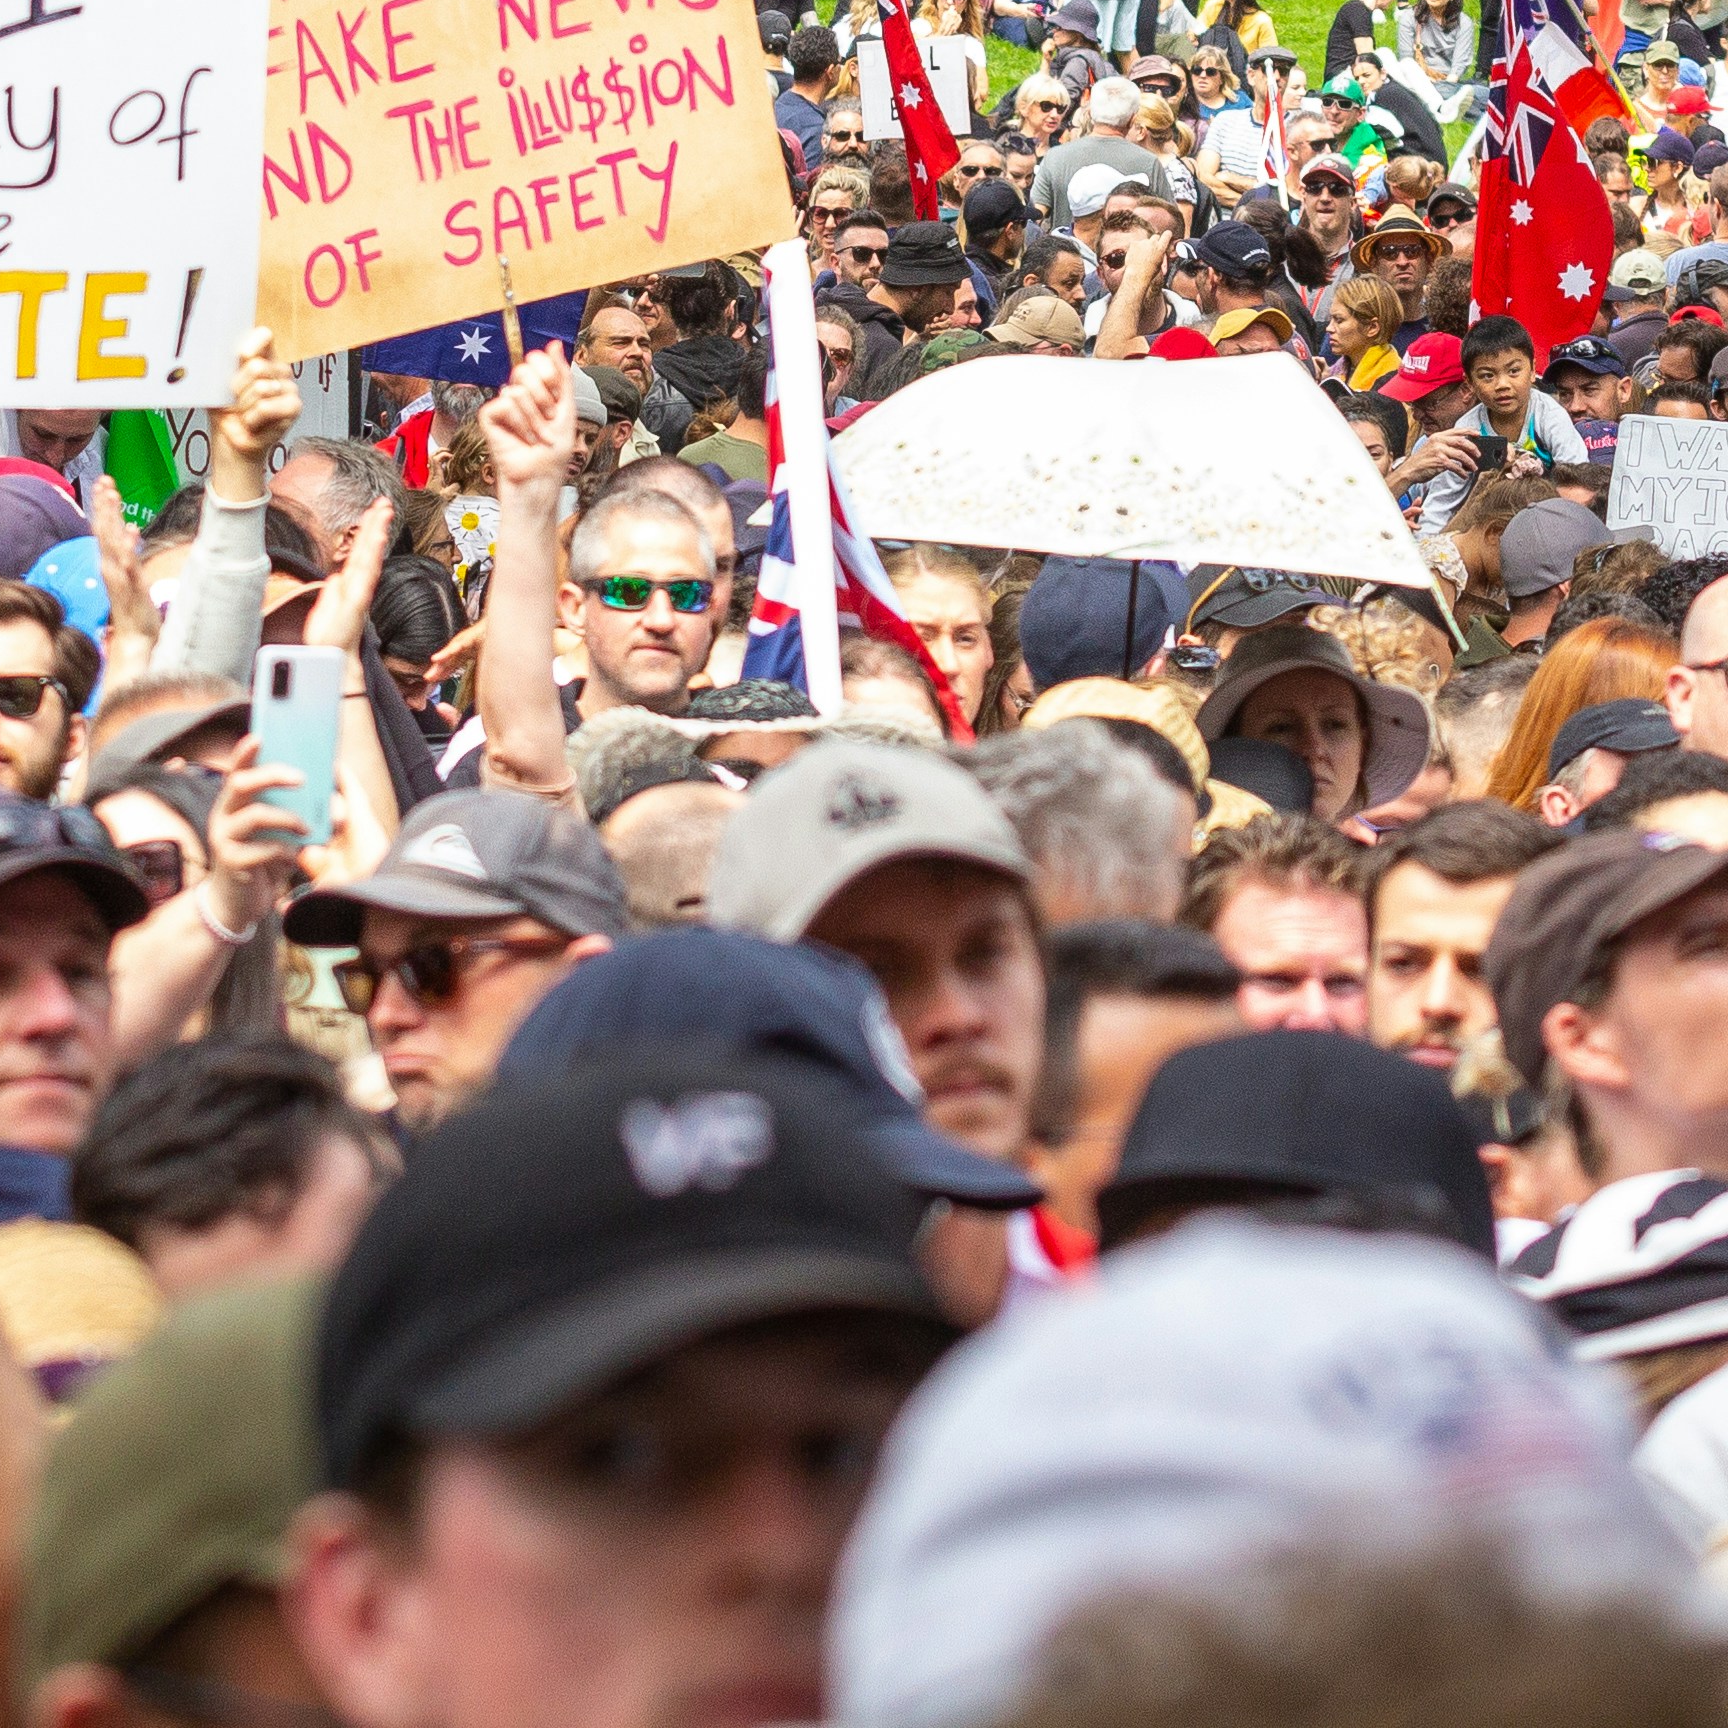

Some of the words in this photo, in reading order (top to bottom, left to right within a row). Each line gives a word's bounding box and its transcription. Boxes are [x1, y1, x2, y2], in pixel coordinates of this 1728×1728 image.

[109, 67, 211, 182] of
[262, 121, 352, 220] ND
[386, 96, 489, 178] THE
[304, 229, 382, 307] OF
[444, 139, 679, 268] SAFETY
[1619, 475, 1692, 522] MY
[1626, 420, 1645, 467] I
